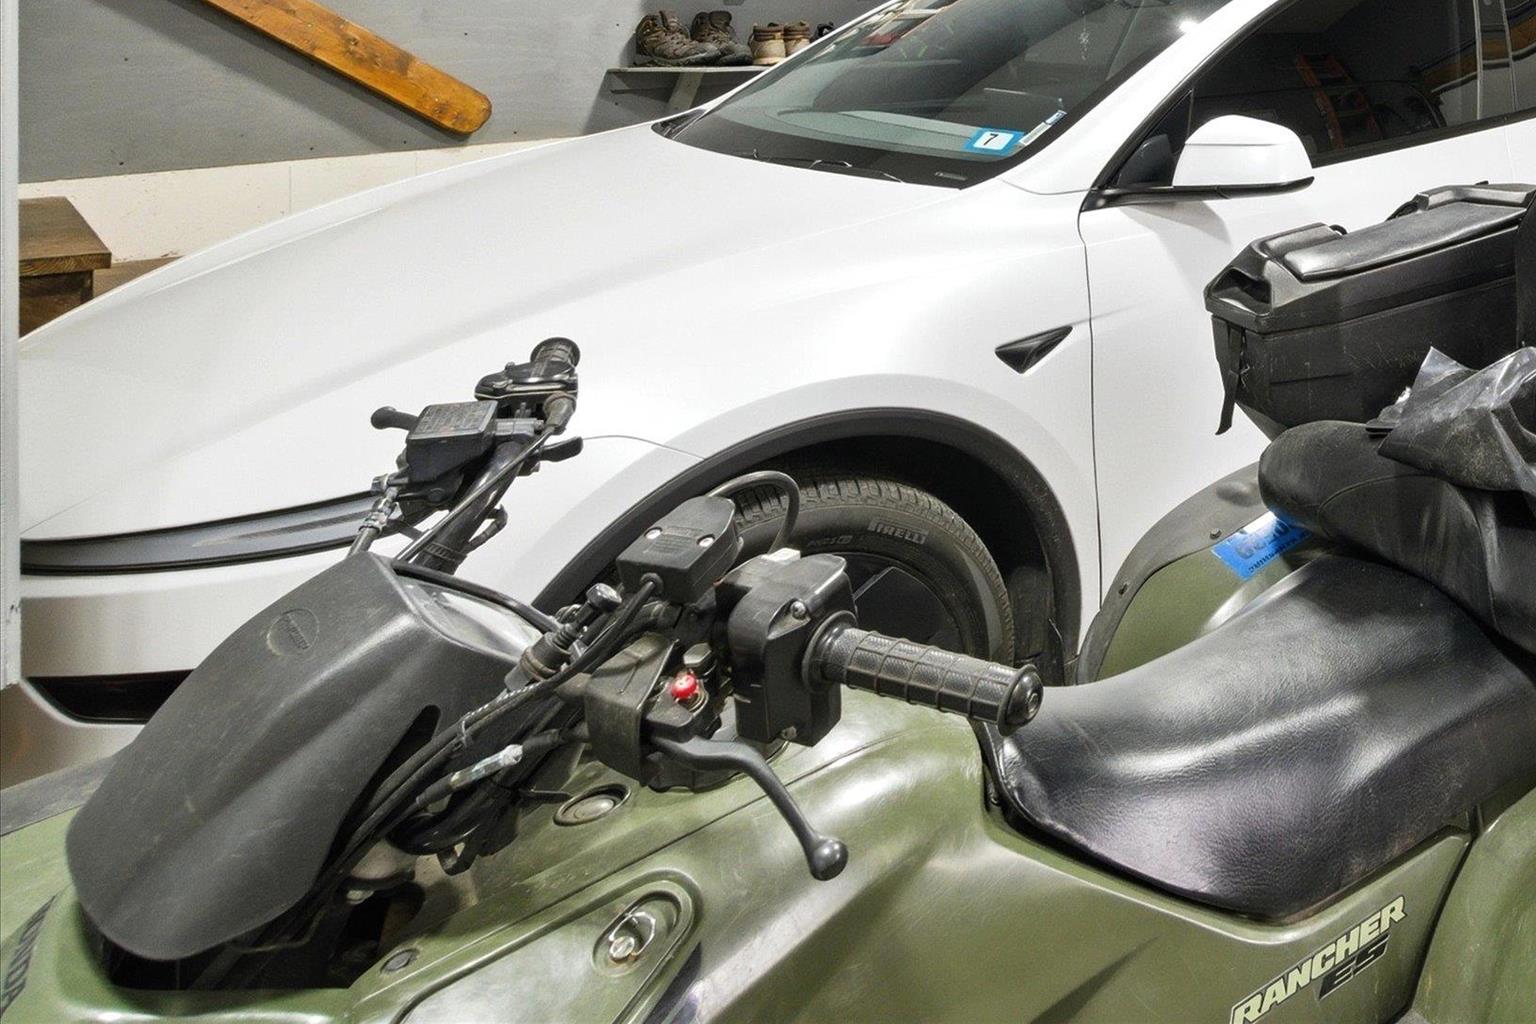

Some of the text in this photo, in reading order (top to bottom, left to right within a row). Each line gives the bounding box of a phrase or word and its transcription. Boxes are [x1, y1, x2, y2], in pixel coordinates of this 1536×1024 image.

[983, 132, 999, 146] 7
[867, 517, 929, 545] PIRELLI
[1230, 895, 1408, 1024] RANCHER
[1318, 931, 1392, 1001] ES
